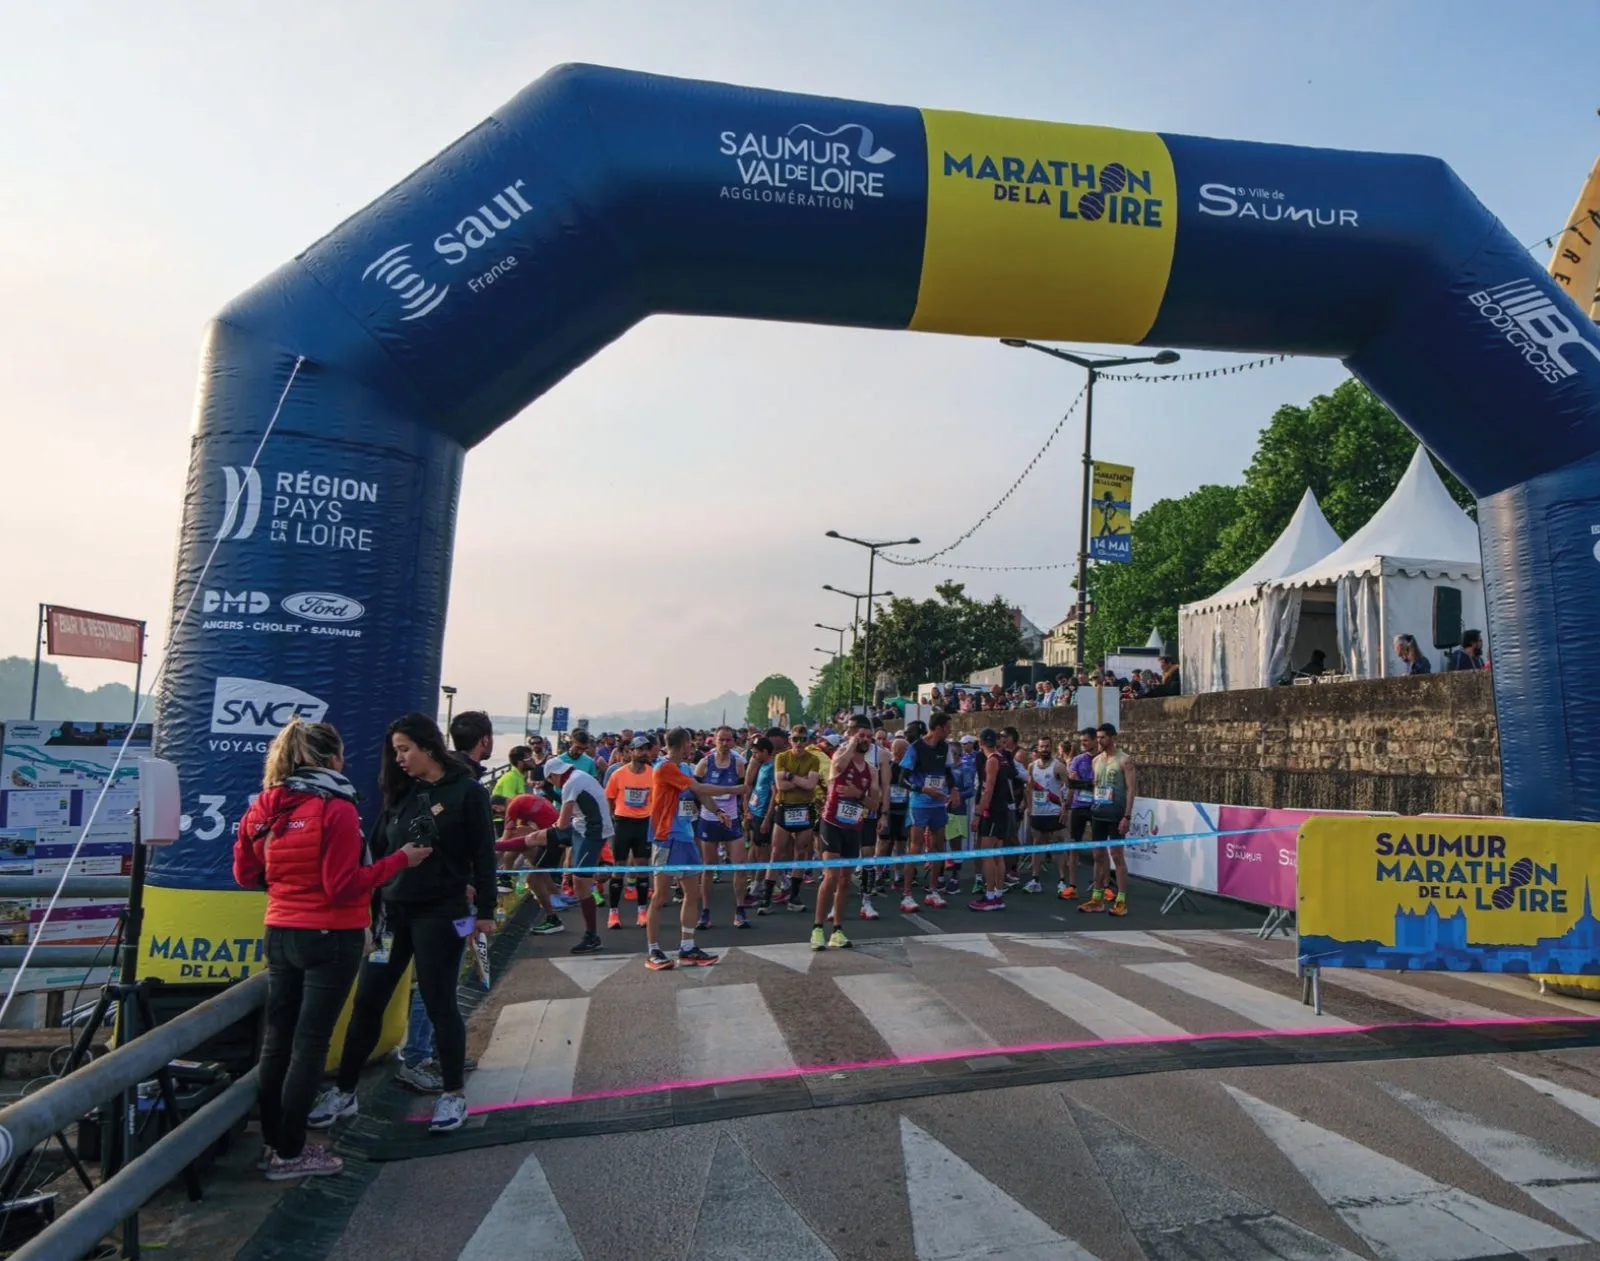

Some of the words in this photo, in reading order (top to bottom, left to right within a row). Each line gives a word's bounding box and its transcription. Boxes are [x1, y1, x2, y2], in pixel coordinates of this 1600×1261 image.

[719, 131, 851, 166] SAUMUR
[736, 158, 787, 187] VAL
[785, 164, 808, 180] DE
[811, 166, 884, 197] LOIRE
[943, 151, 1152, 195] MARATHON
[719, 186, 854, 210] AGGLOMÉRATION
[994, 183, 1020, 202] DE
[1025, 187, 1052, 206] LA
[1059, 190, 1163, 228] LOIRE
[1198, 183, 1359, 228] SAUMUR
[1248, 187, 1270, 199] Ville
[1271, 189, 1285, 200] de
[433, 178, 534, 266] saur
[467, 255, 519, 293] France
[1468, 291, 1567, 384] BODYCROSS
[276, 470, 379, 503] RÉGION
[1093, 472, 1132, 482] MARATHON
[273, 496, 343, 523] PAYS
[270, 531, 287, 542] LA
[296, 522, 374, 551] LOIRE
[271, 519, 289, 531] DE
[1095, 539, 1106, 549] 14
[1108, 540, 1129, 552] MAI
[299, 596, 349, 618] Ford
[59, 612, 77, 635] BAR
[202, 620, 244, 630] ANGERS
[252, 622, 301, 633] CHOLET
[311, 626, 362, 638] SAUMUR
[209, 740, 267, 753] VOYAG
[1226, 843, 1262, 862] SAUMUR
[1375, 832, 1506, 859] SAUMUR
[1376, 858, 1558, 886] MARATHON
[1418, 886, 1441, 899] DE
[1445, 887, 1468, 900] LA
[1475, 886, 1568, 913] LOIRE
[180, 964, 203, 977] DE
[207, 965, 231, 978] LA
